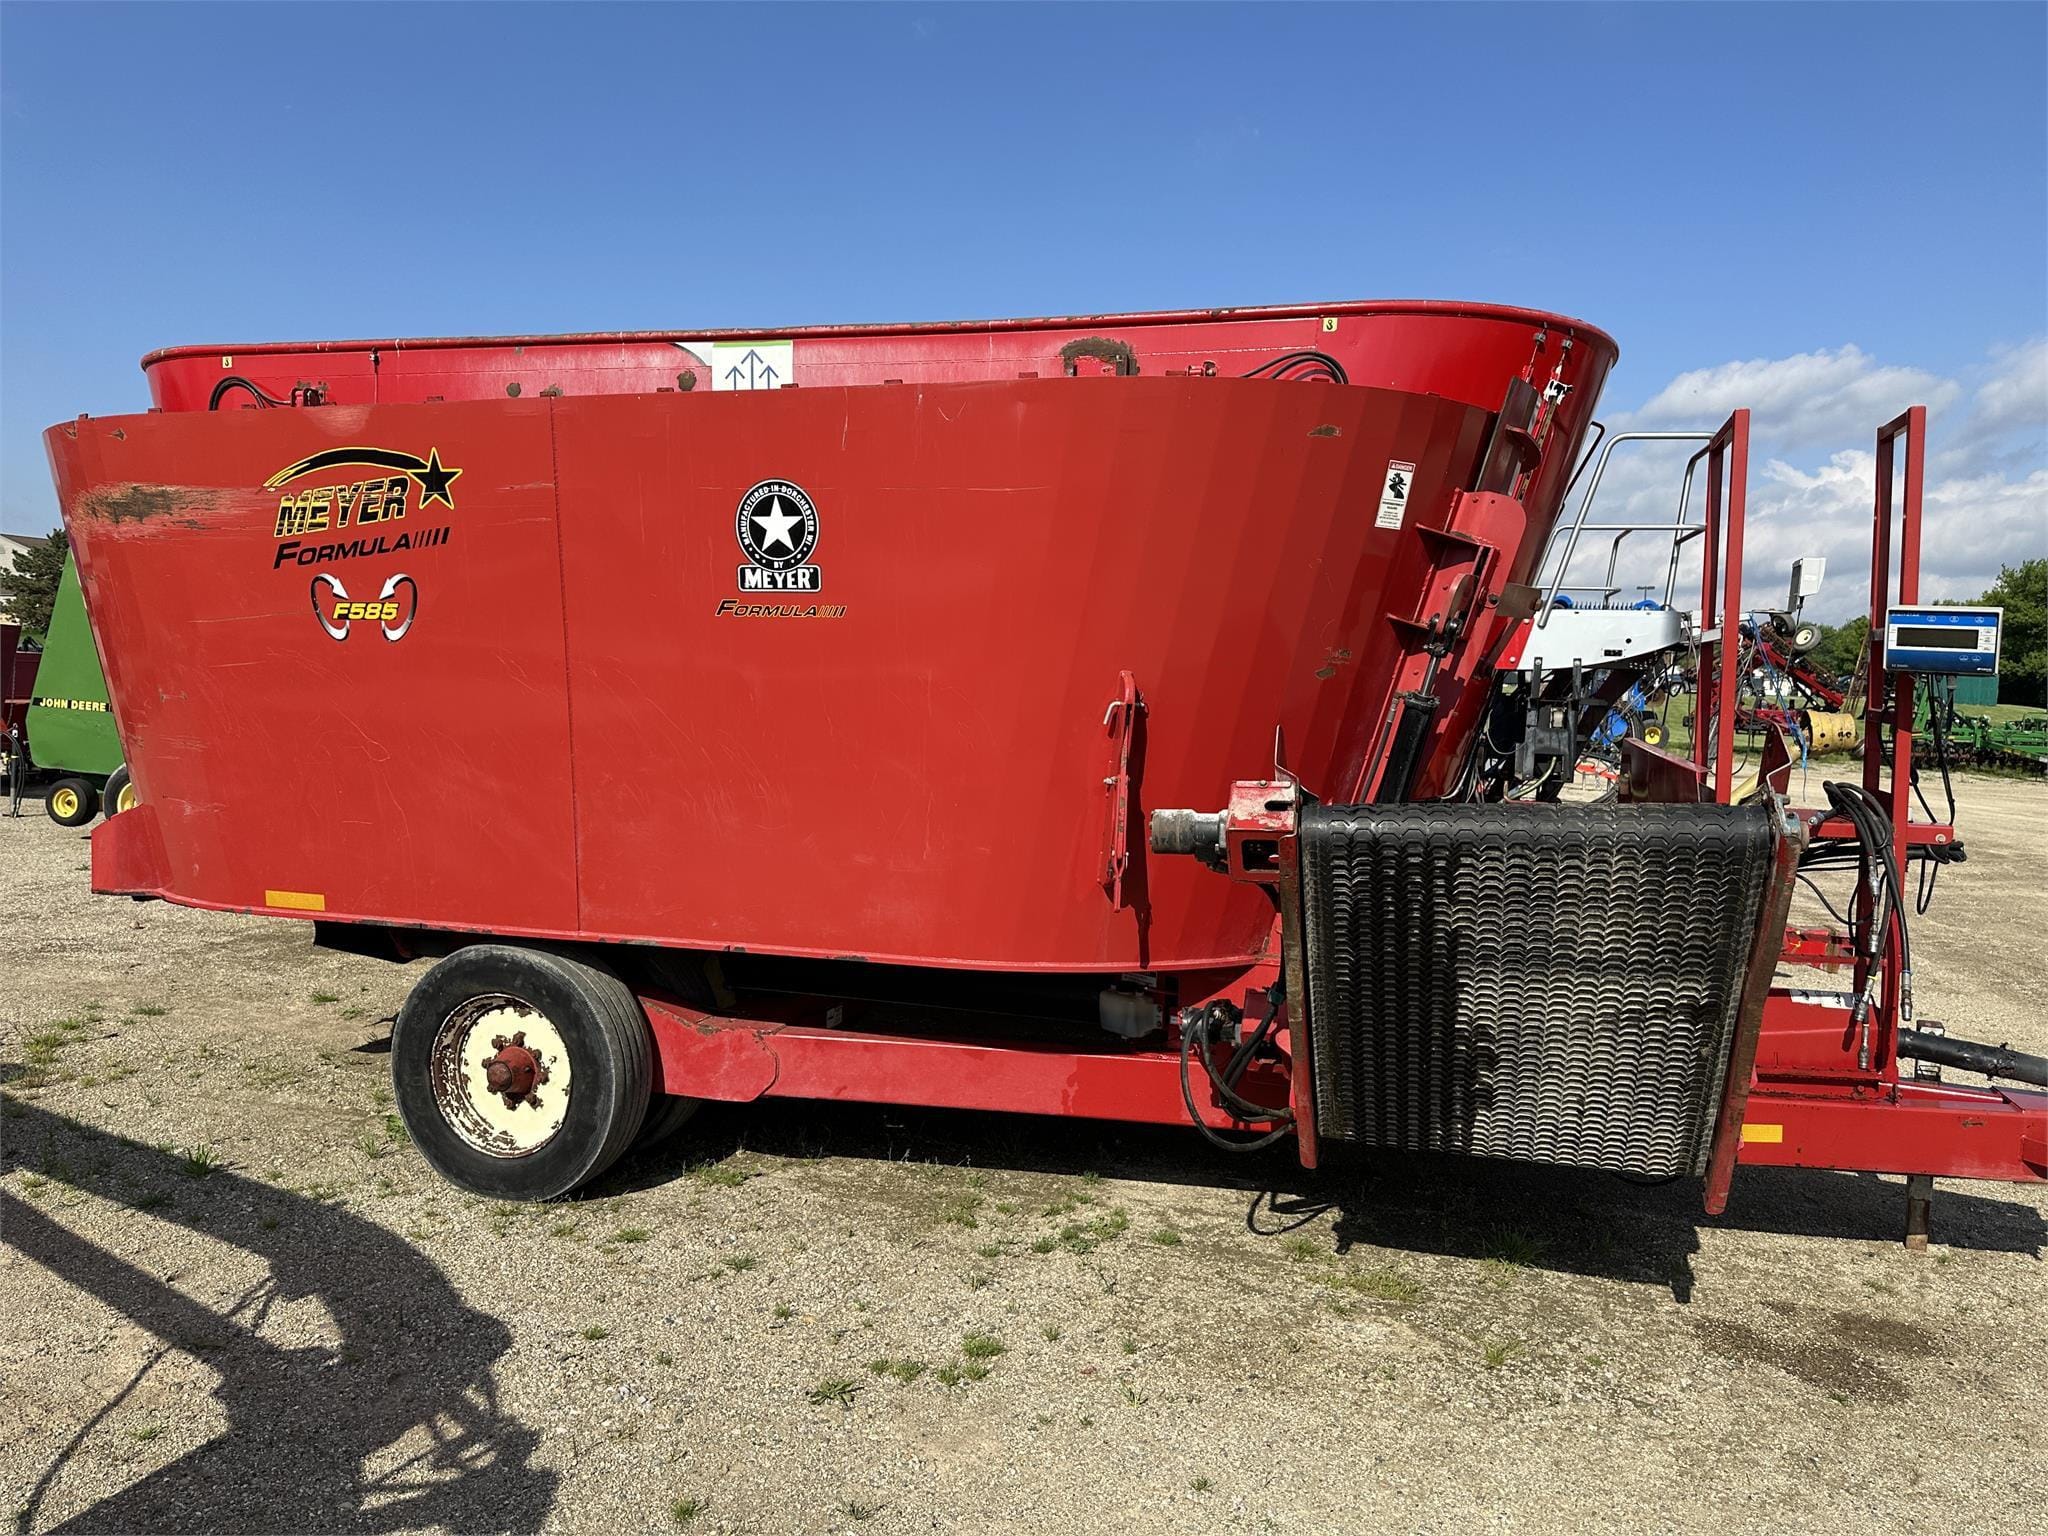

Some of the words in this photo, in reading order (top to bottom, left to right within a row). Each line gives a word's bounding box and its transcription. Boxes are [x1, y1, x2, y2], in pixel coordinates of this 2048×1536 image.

[274, 475, 410, 537] MEYER
[740, 486, 769, 546] MANUFACTURED
[781, 485, 815, 532] DORCHESTER
[806, 534, 814, 545] WI
[773, 561, 784, 569] BY
[744, 568, 812, 589] MEYER
[332, 602, 399, 621] F585
[40, 698, 68, 709] JOHN
[70, 700, 107, 712] DEERE
